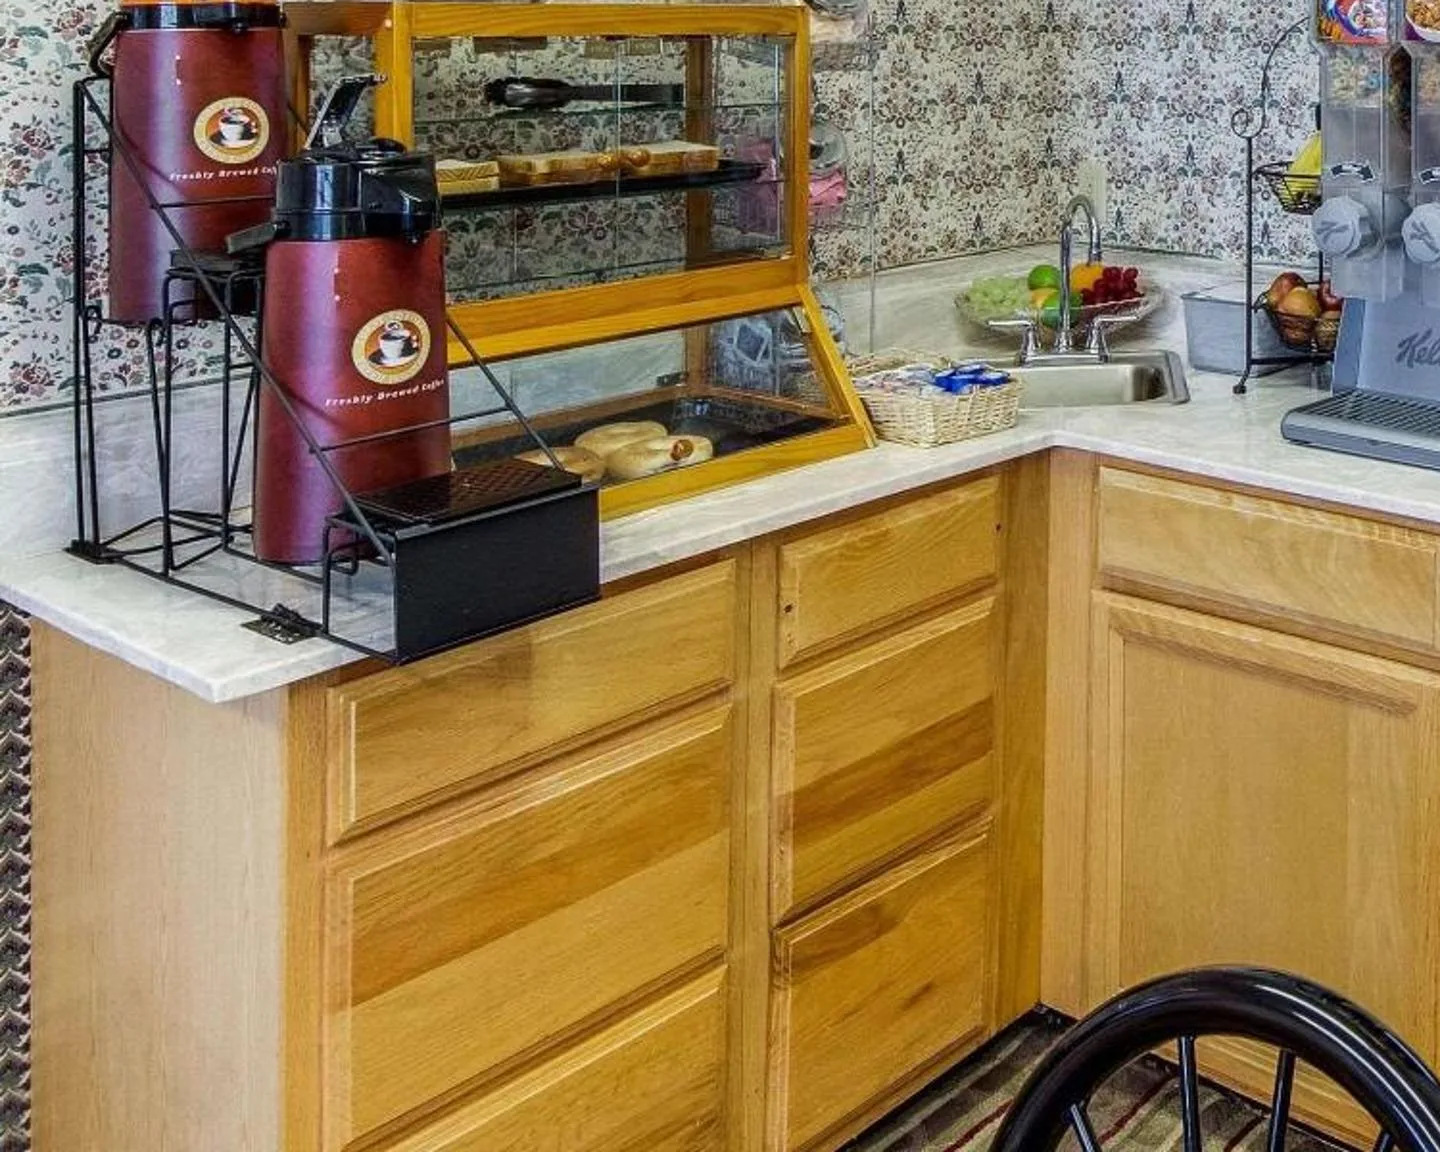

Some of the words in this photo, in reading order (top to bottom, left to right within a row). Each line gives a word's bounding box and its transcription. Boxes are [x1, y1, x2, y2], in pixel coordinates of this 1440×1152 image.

[169, 170, 215, 181] Freshly
[218, 167, 258, 177] Brewed
[325, 393, 373, 406] Freshly
[377, 384, 419, 400] Brewed
